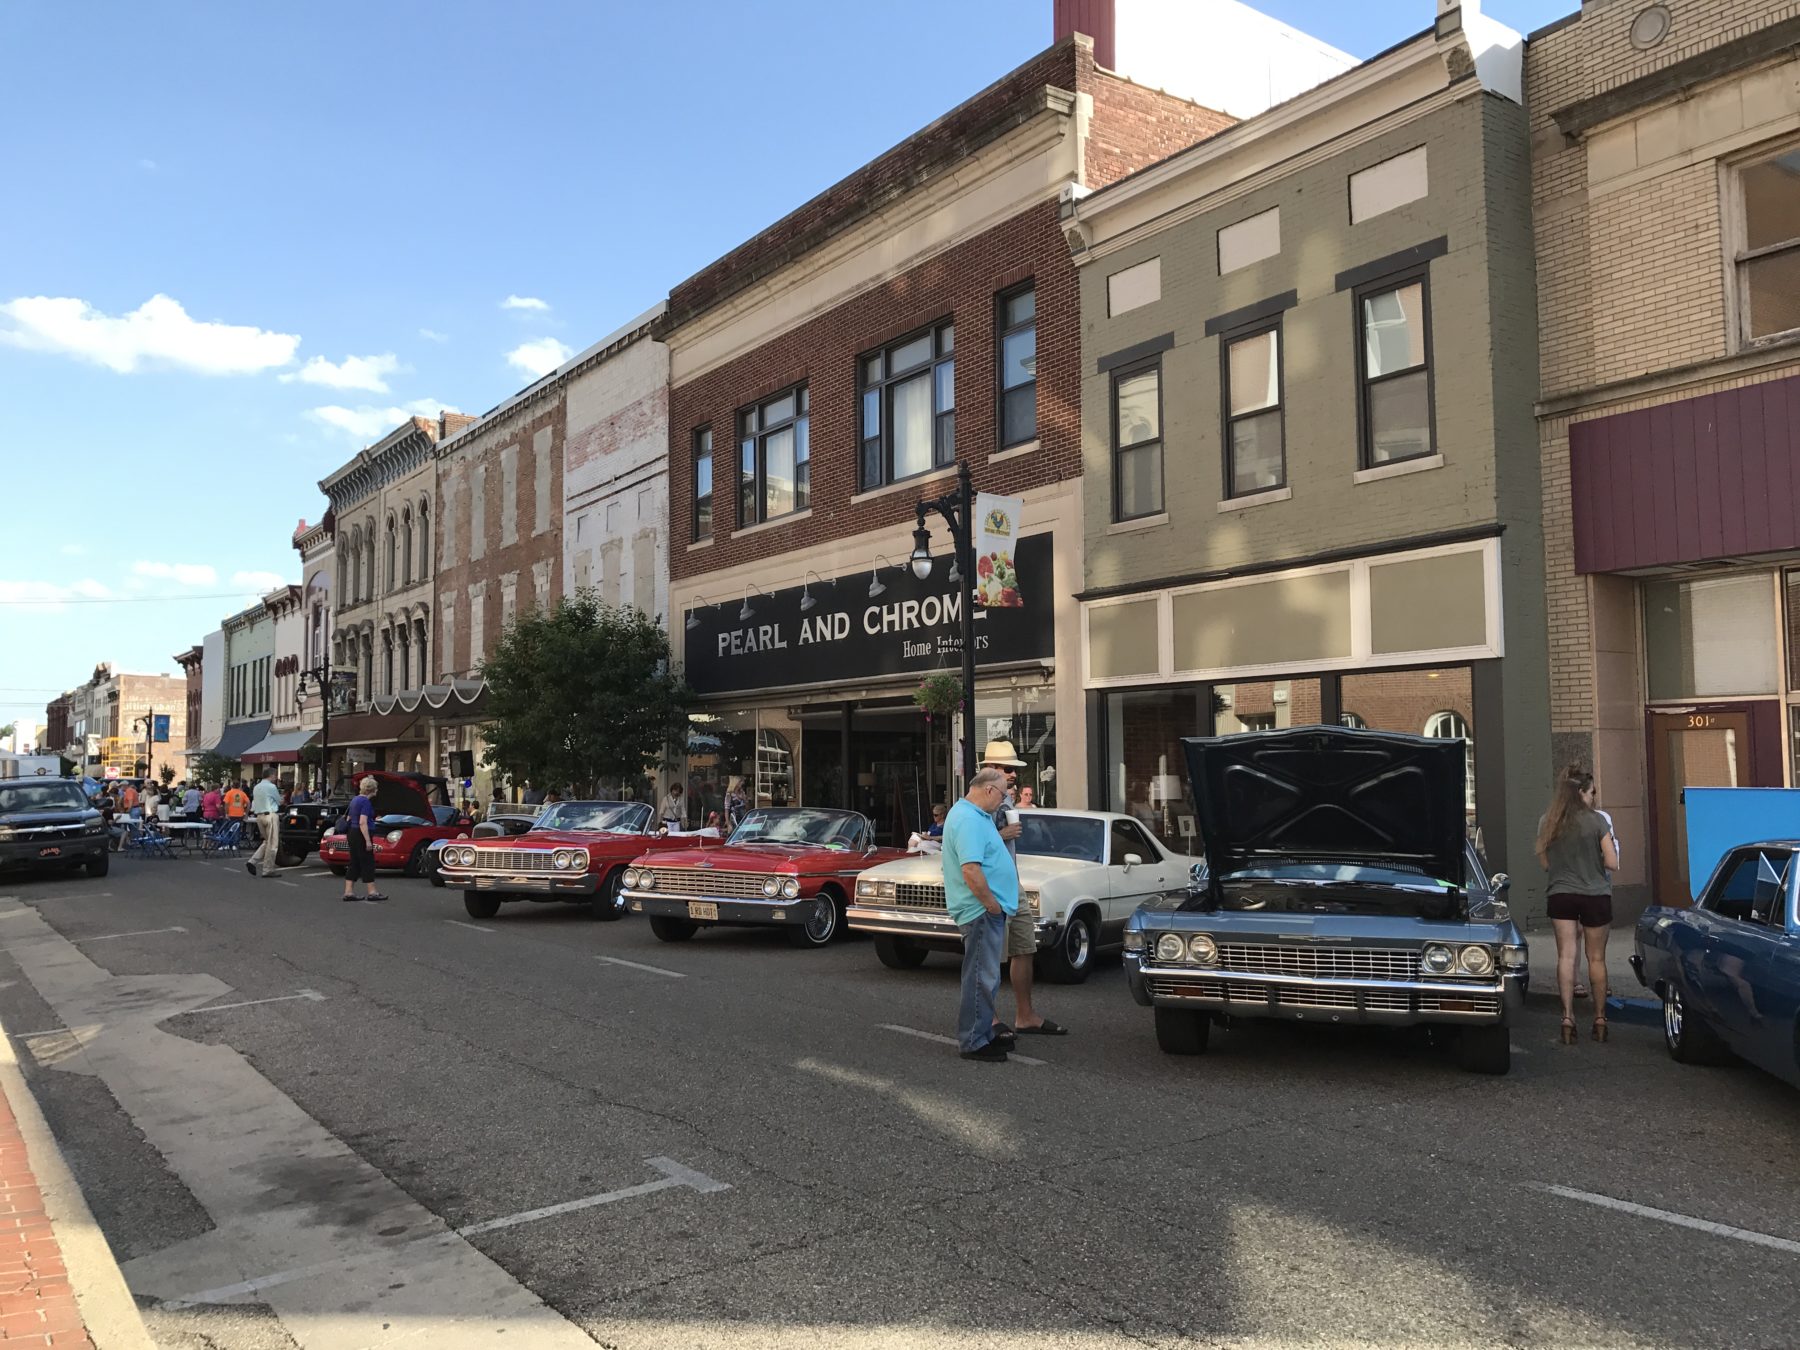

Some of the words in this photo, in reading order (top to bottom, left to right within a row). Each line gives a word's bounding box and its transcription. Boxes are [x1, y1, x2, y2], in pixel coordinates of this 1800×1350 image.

[718, 623, 787, 657] PEARL
[798, 612, 850, 645] AND
[903, 640, 932, 658] Home
[937, 635, 989, 654] Interrs
[1687, 715, 1709, 727] 301
